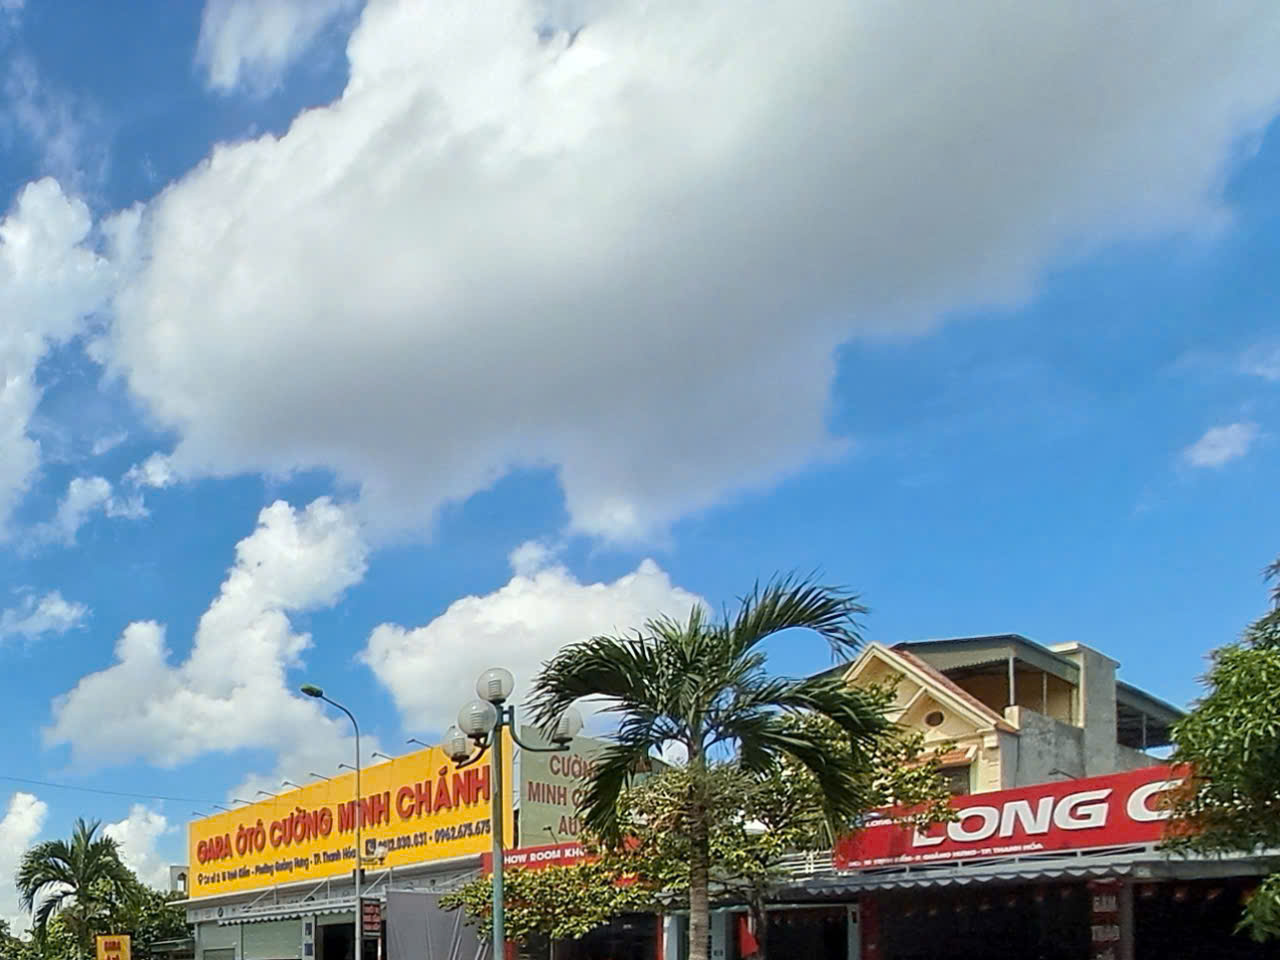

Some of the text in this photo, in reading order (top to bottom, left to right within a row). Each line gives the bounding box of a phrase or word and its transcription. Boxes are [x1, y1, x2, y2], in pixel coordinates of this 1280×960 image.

[550, 753, 596, 779] CƯỜN
[528, 780, 568, 807] MINH
[196, 833, 233, 864] GARA
[269, 806, 333, 848] CƯỜNG
[395, 766, 491, 820] CHÁNH
[912, 788, 1113, 848] LONG
[503, 854, 527, 863] HOW
[530, 849, 561, 861] ROOM
